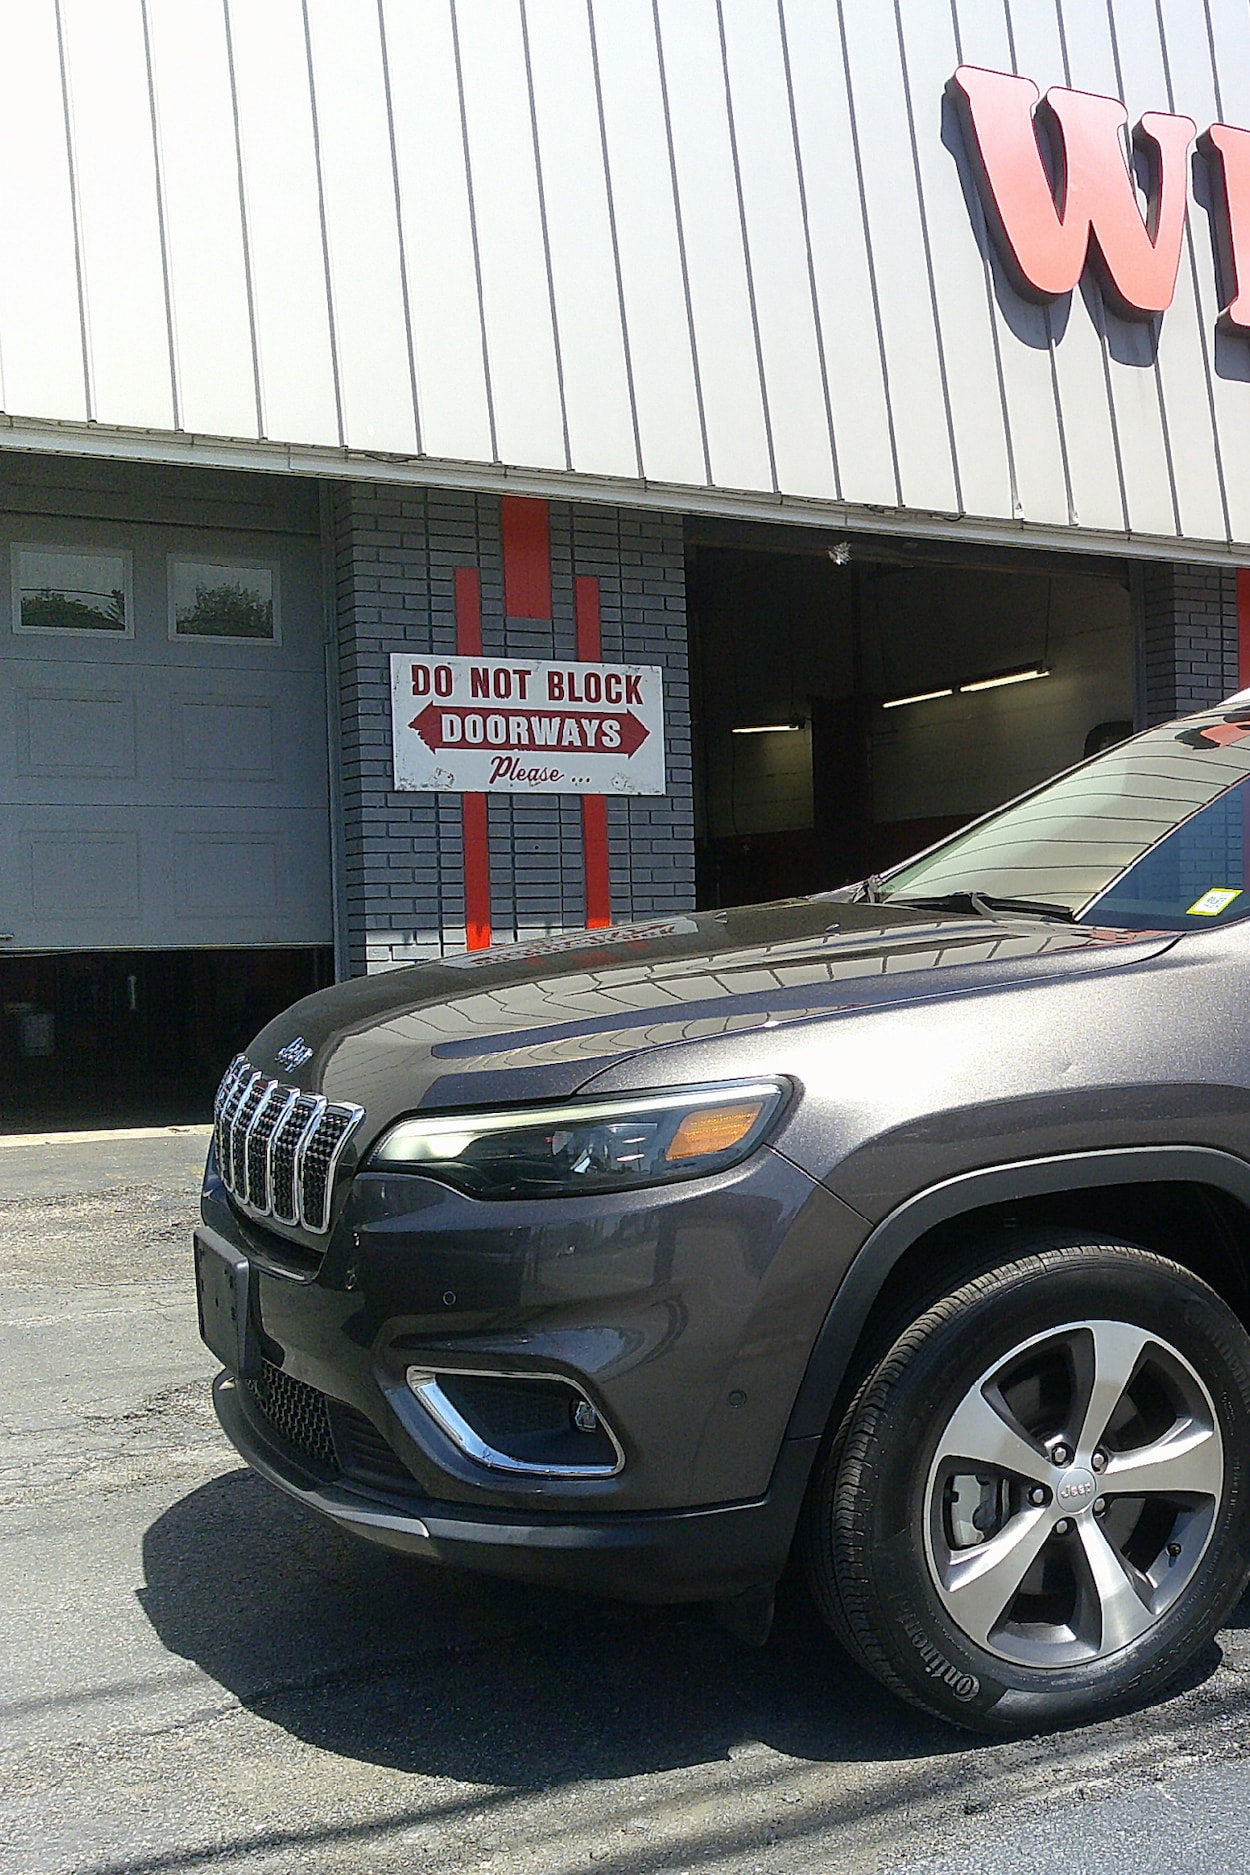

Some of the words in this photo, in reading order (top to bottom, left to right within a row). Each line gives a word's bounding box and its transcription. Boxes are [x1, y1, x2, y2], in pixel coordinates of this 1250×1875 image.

[411, 664, 453, 698] DO
[470, 667, 532, 700] NOT
[547, 670, 644, 705] BLOCK
[441, 713, 621, 748] DOORWAYS
[489, 755, 565, 785] Please
